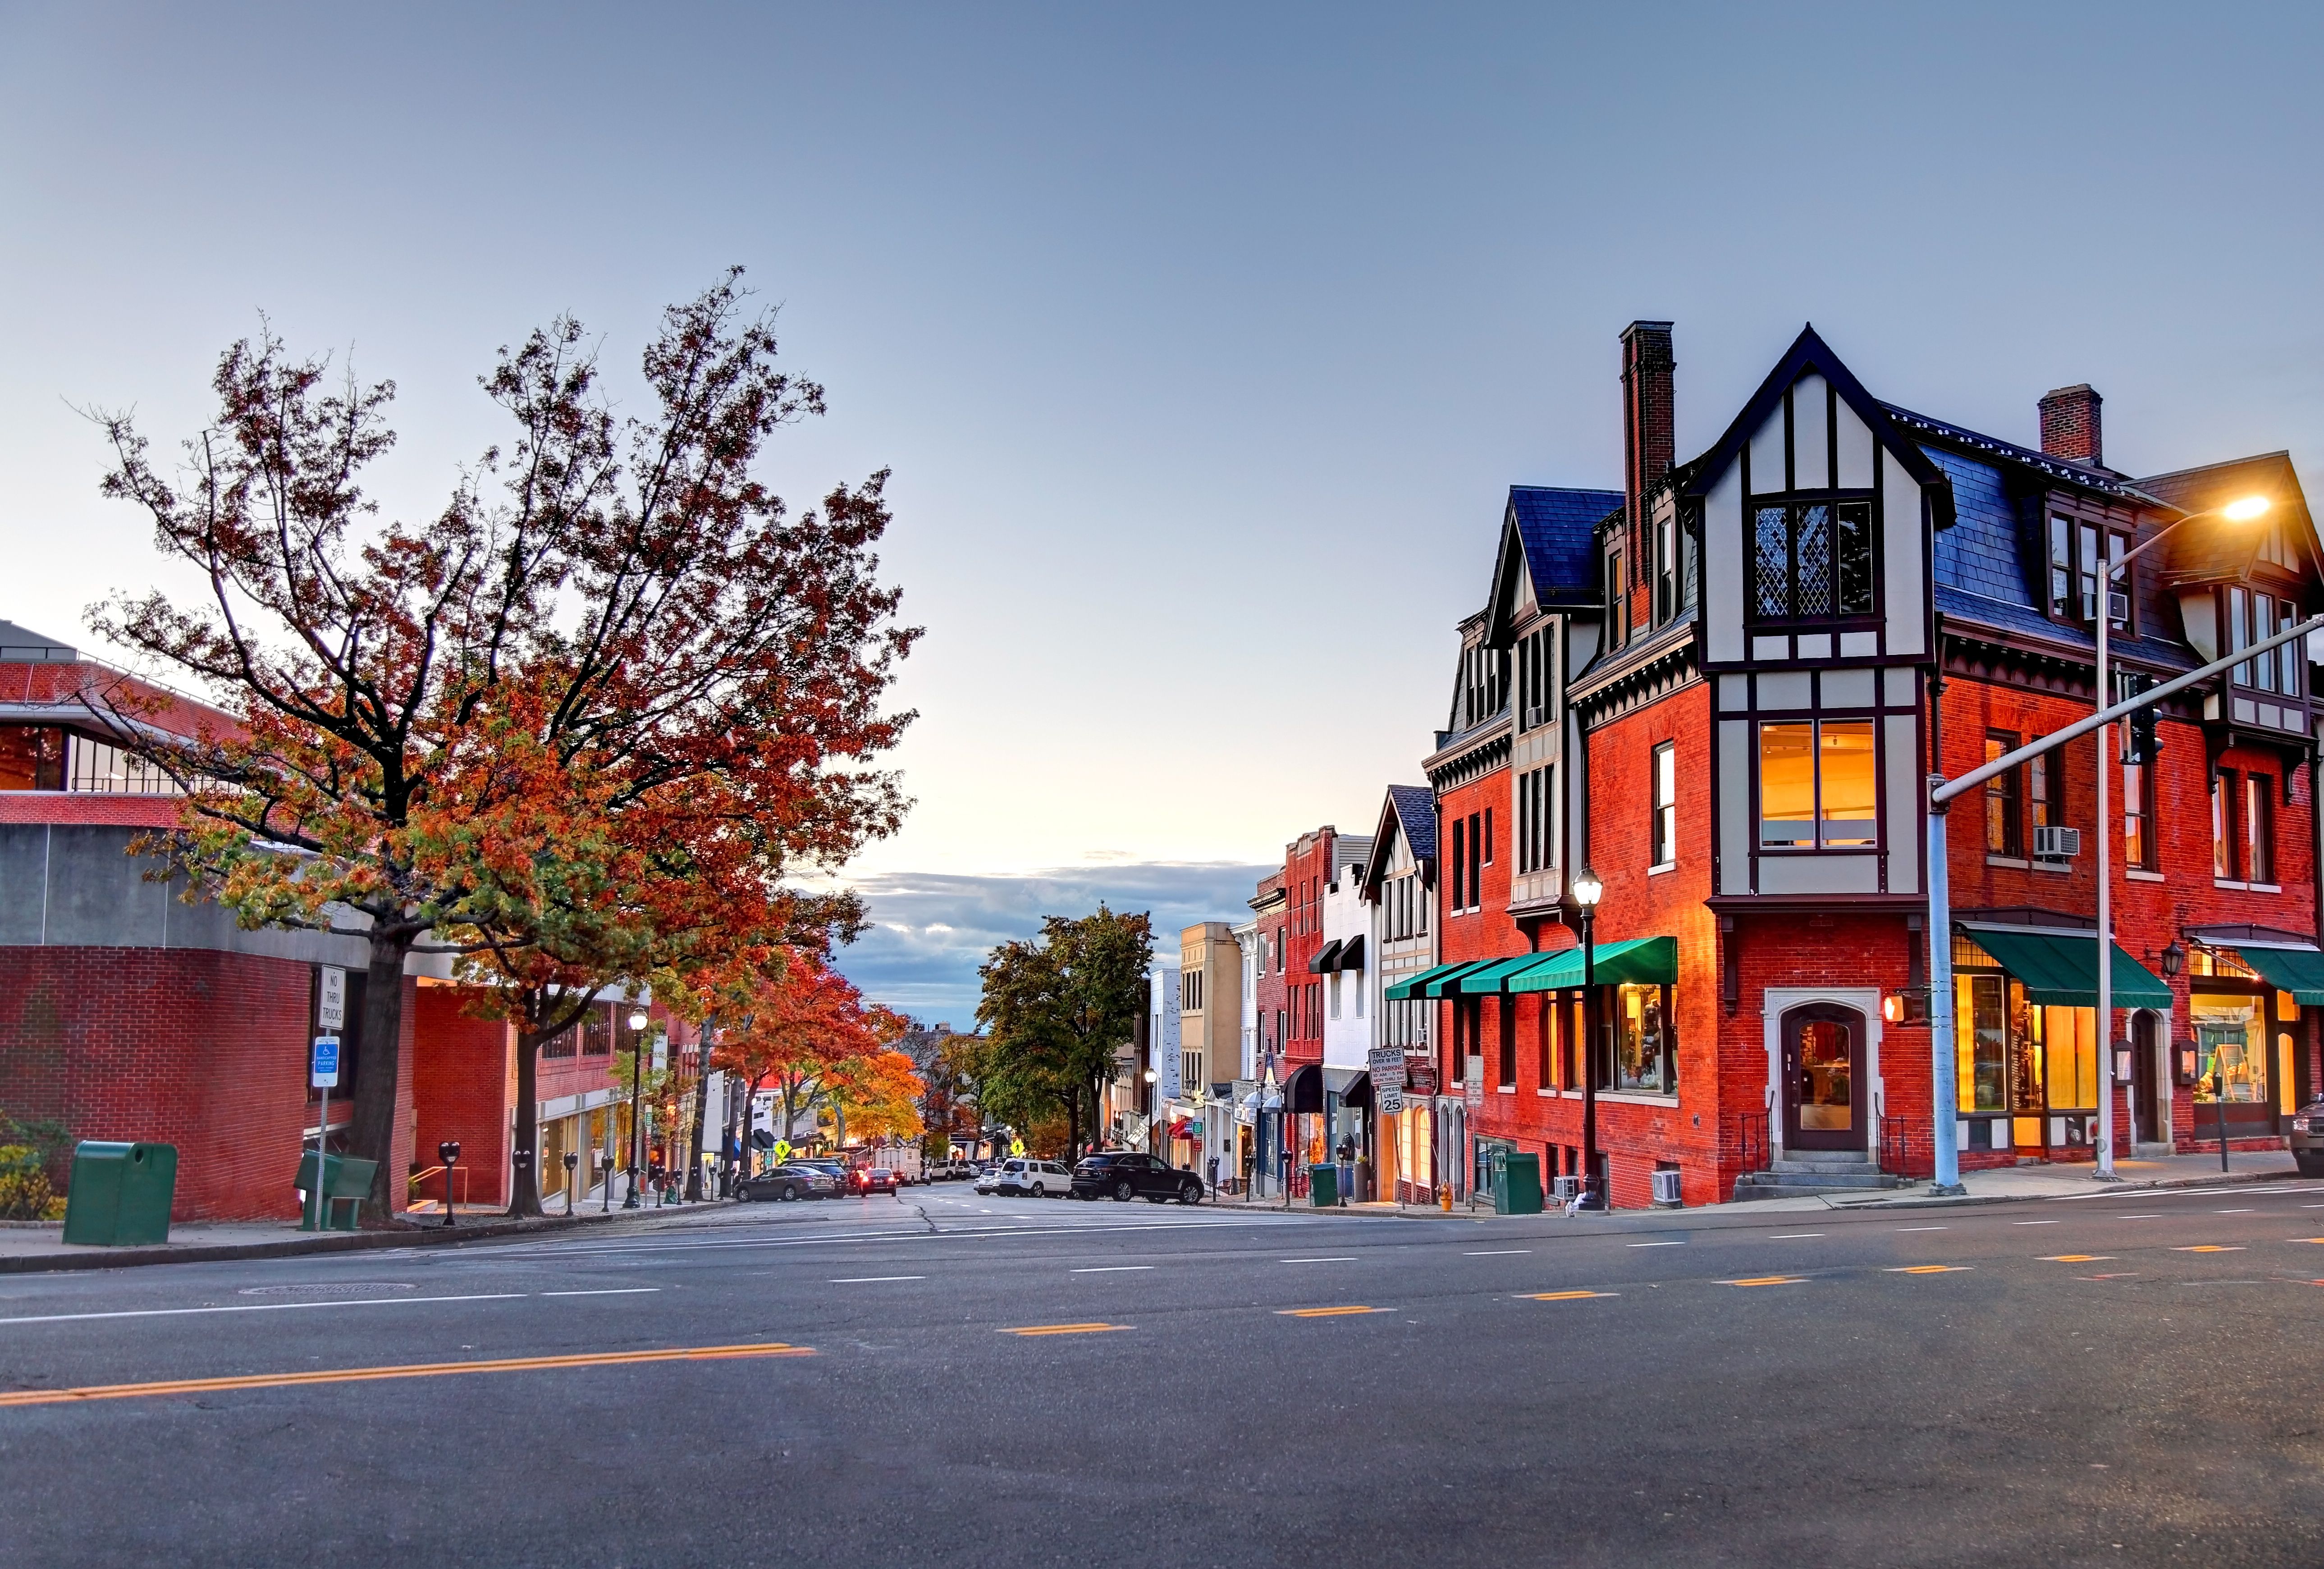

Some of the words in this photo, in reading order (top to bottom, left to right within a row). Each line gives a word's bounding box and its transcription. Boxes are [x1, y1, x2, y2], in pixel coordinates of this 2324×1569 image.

[330, 975, 337, 987] NO
[327, 991, 340, 1004] THRU
[323, 1007, 342, 1020] TRUCKS
[1372, 1049, 1401, 1058] TRUCKS
[1384, 1099, 1400, 1111] 25
